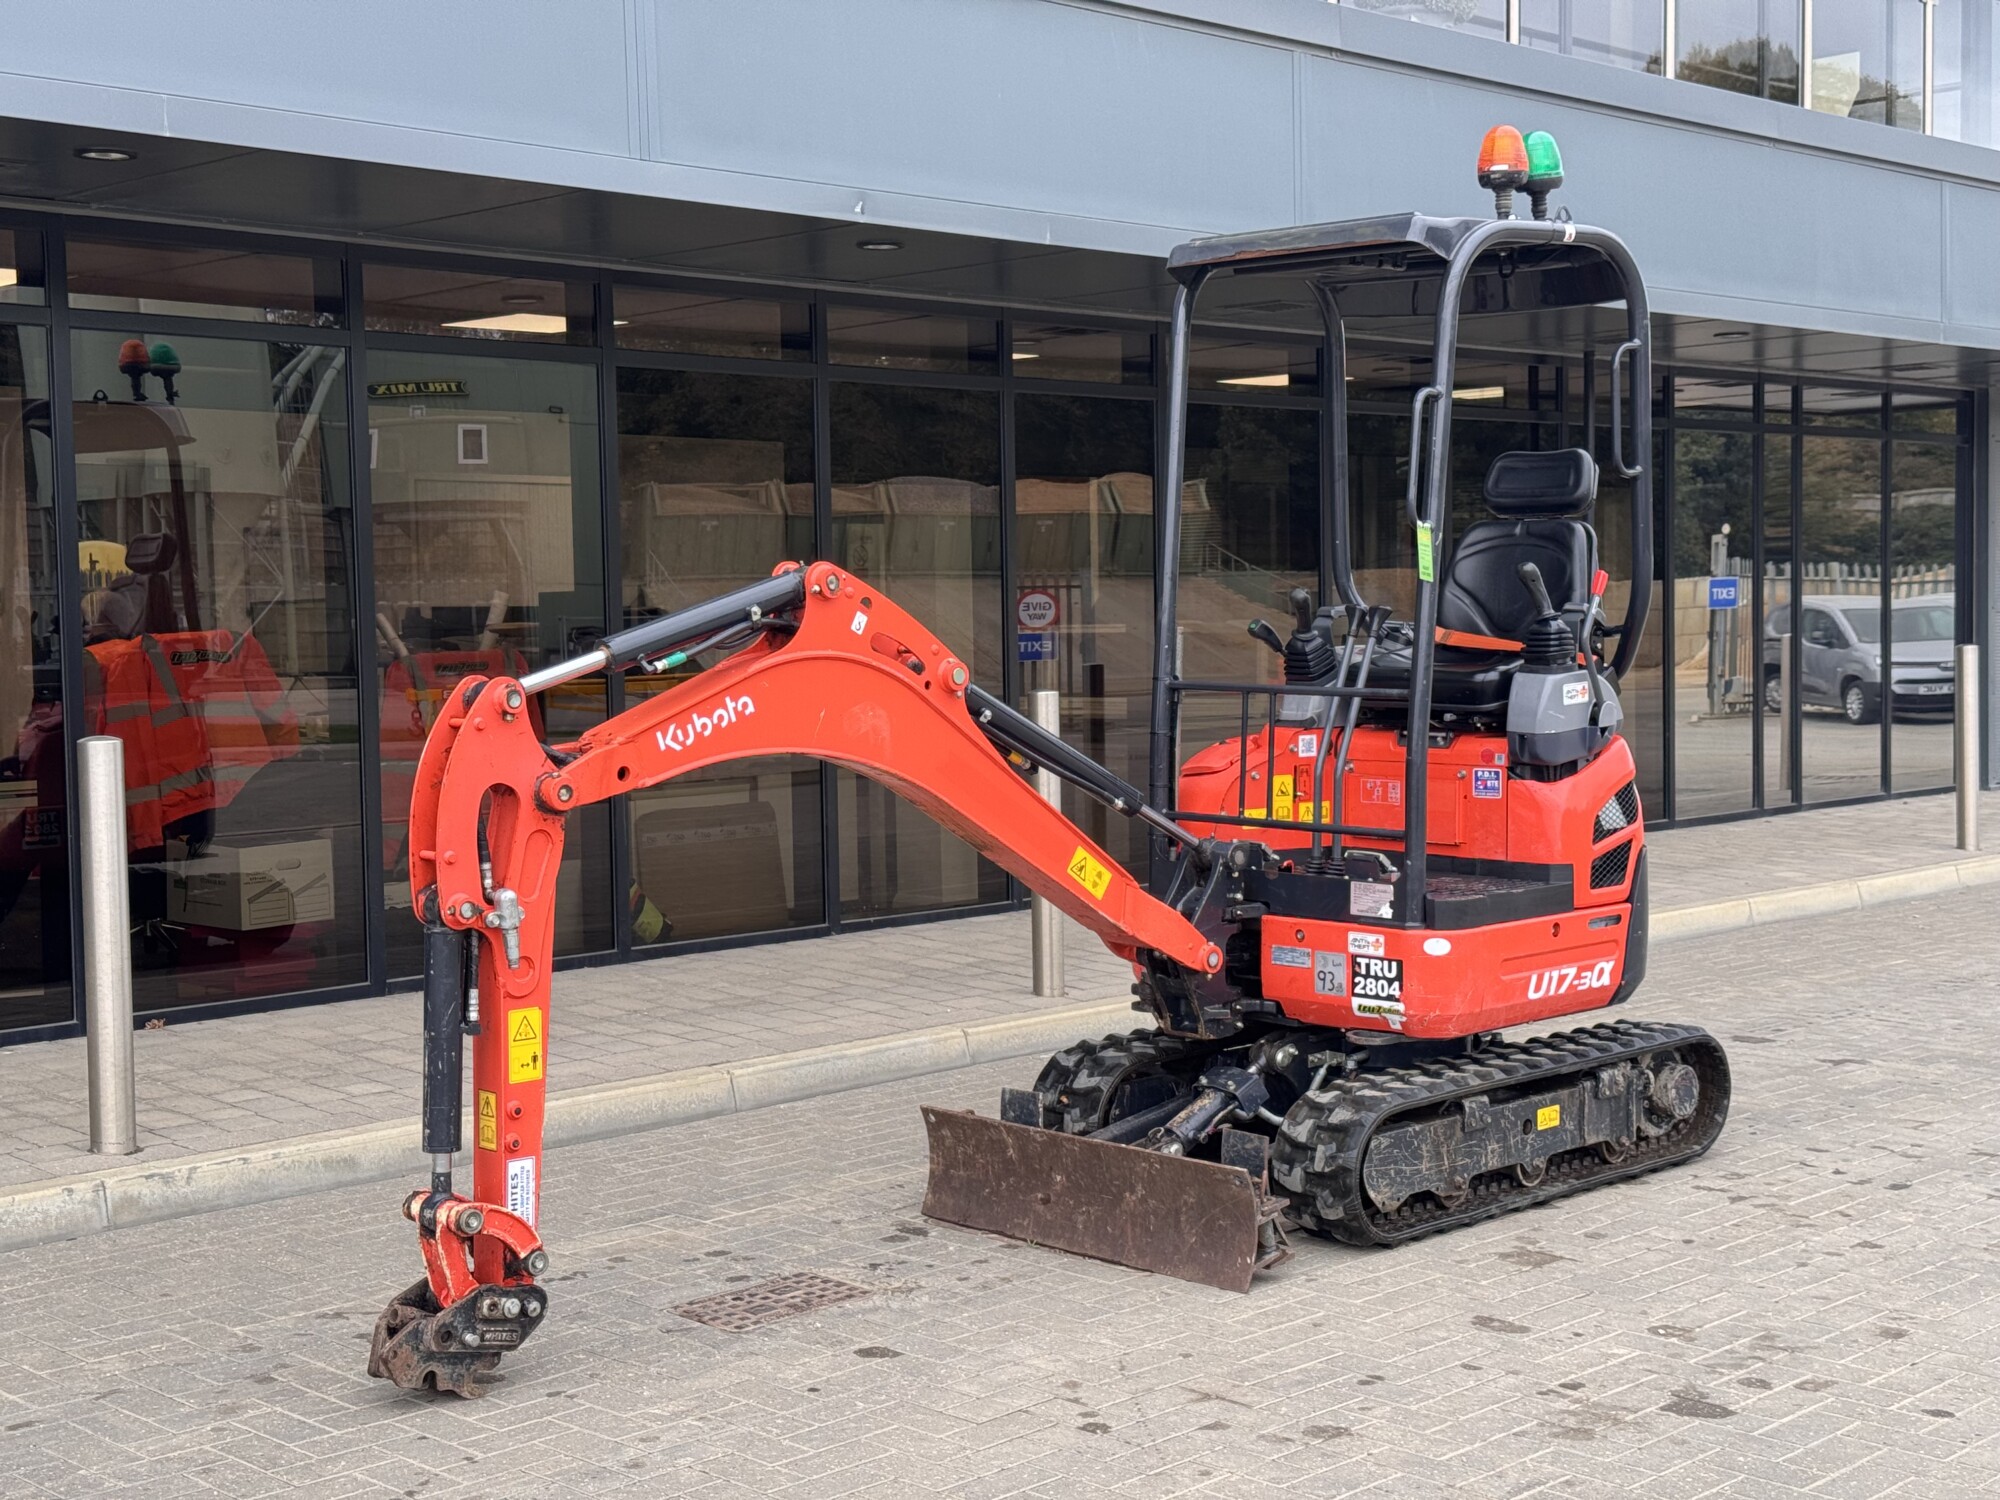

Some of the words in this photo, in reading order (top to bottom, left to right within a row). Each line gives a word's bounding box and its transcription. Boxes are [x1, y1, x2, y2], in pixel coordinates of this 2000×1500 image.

[656, 695, 756, 752] Kubota
[1356, 957, 1398, 979] TRU
[1317, 970, 1336, 992] 93
[1353, 976, 1401, 998] 2804
[510, 1173, 519, 1212] HITES
